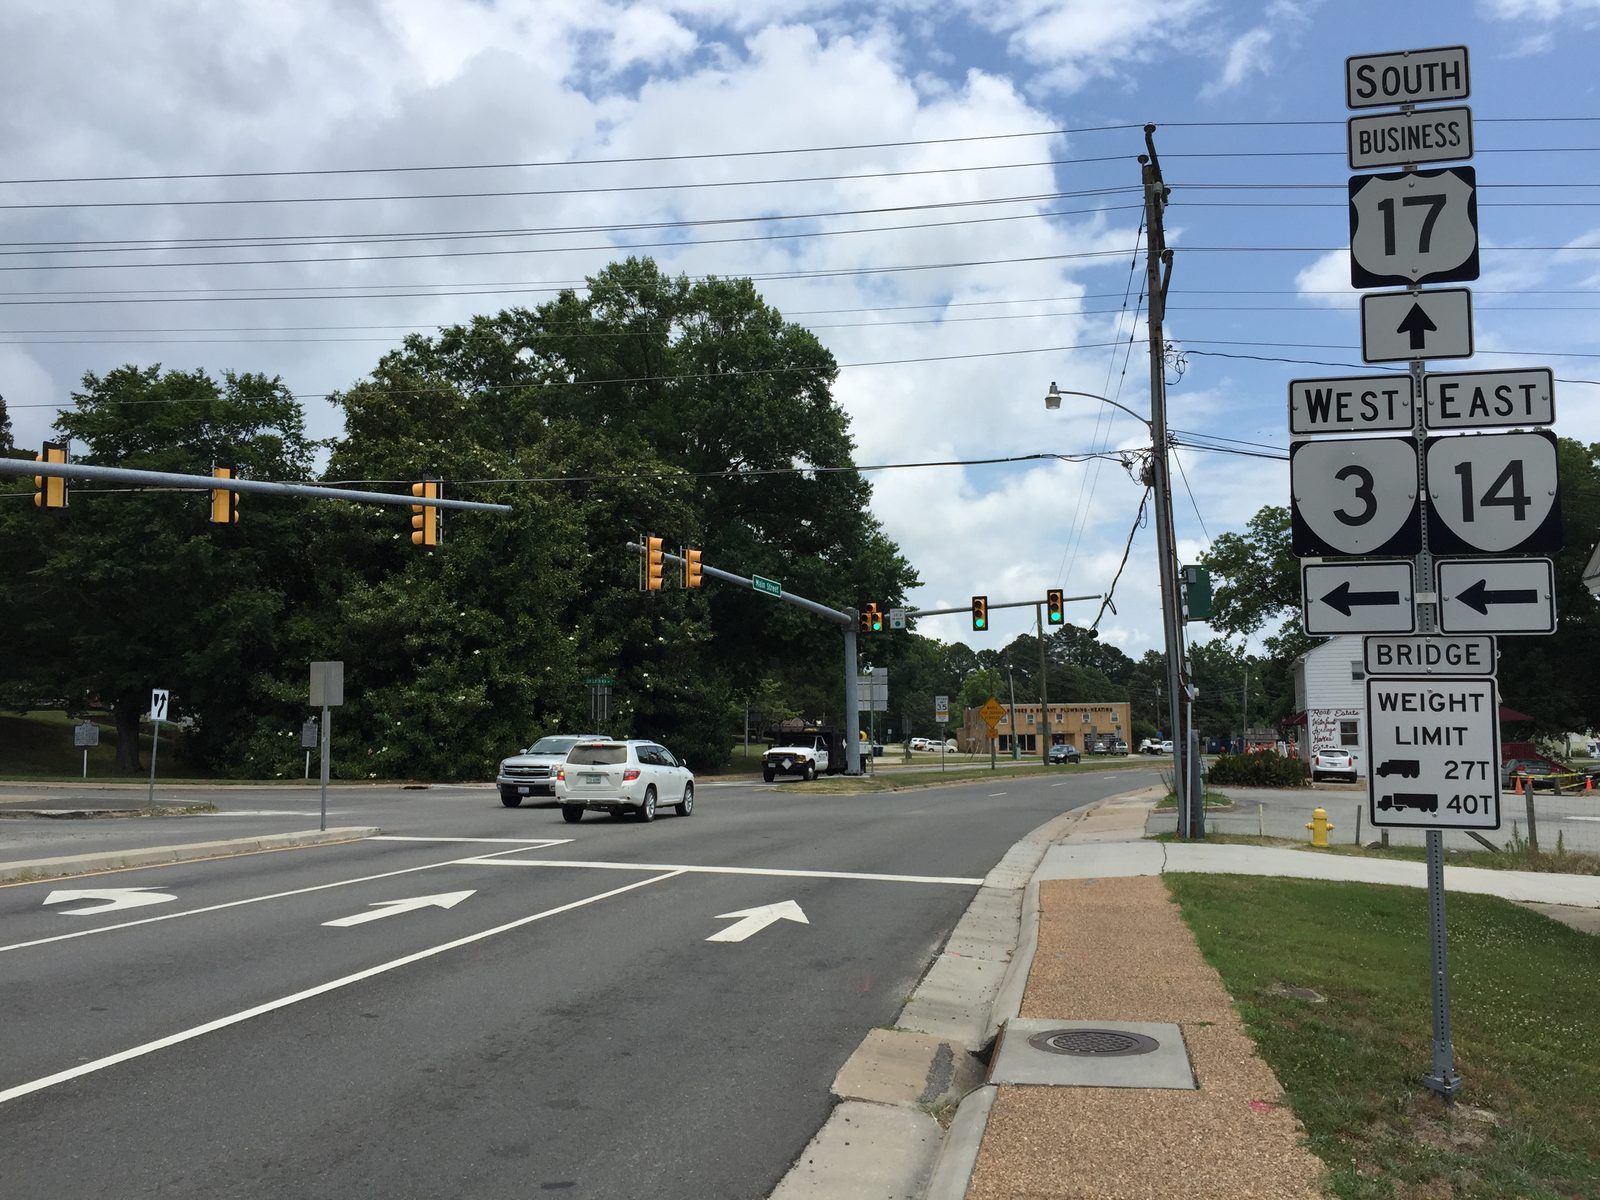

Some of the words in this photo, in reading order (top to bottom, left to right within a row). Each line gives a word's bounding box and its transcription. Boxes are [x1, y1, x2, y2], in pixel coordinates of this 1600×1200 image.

[1356, 61, 1460, 98] SOUTH
[1359, 121, 1461, 155] BUSINESS
[1377, 194, 1447, 256] 17
[1304, 388, 1399, 424] WEST
[1439, 383, 1537, 419] EAST
[1333, 465, 1378, 527] 3
[1454, 459, 1532, 523] 14
[1376, 643, 1481, 666] BRIDGE
[936, 703, 948, 711] 35
[1311, 708, 1331, 717] Real
[1334, 709, 1360, 717] Estate
[1378, 692, 1485, 713] WEIGHT
[1395, 726, 1469, 746] LIMIT
[1444, 760, 1490, 780] 27T
[1446, 794, 1493, 815] 40T
